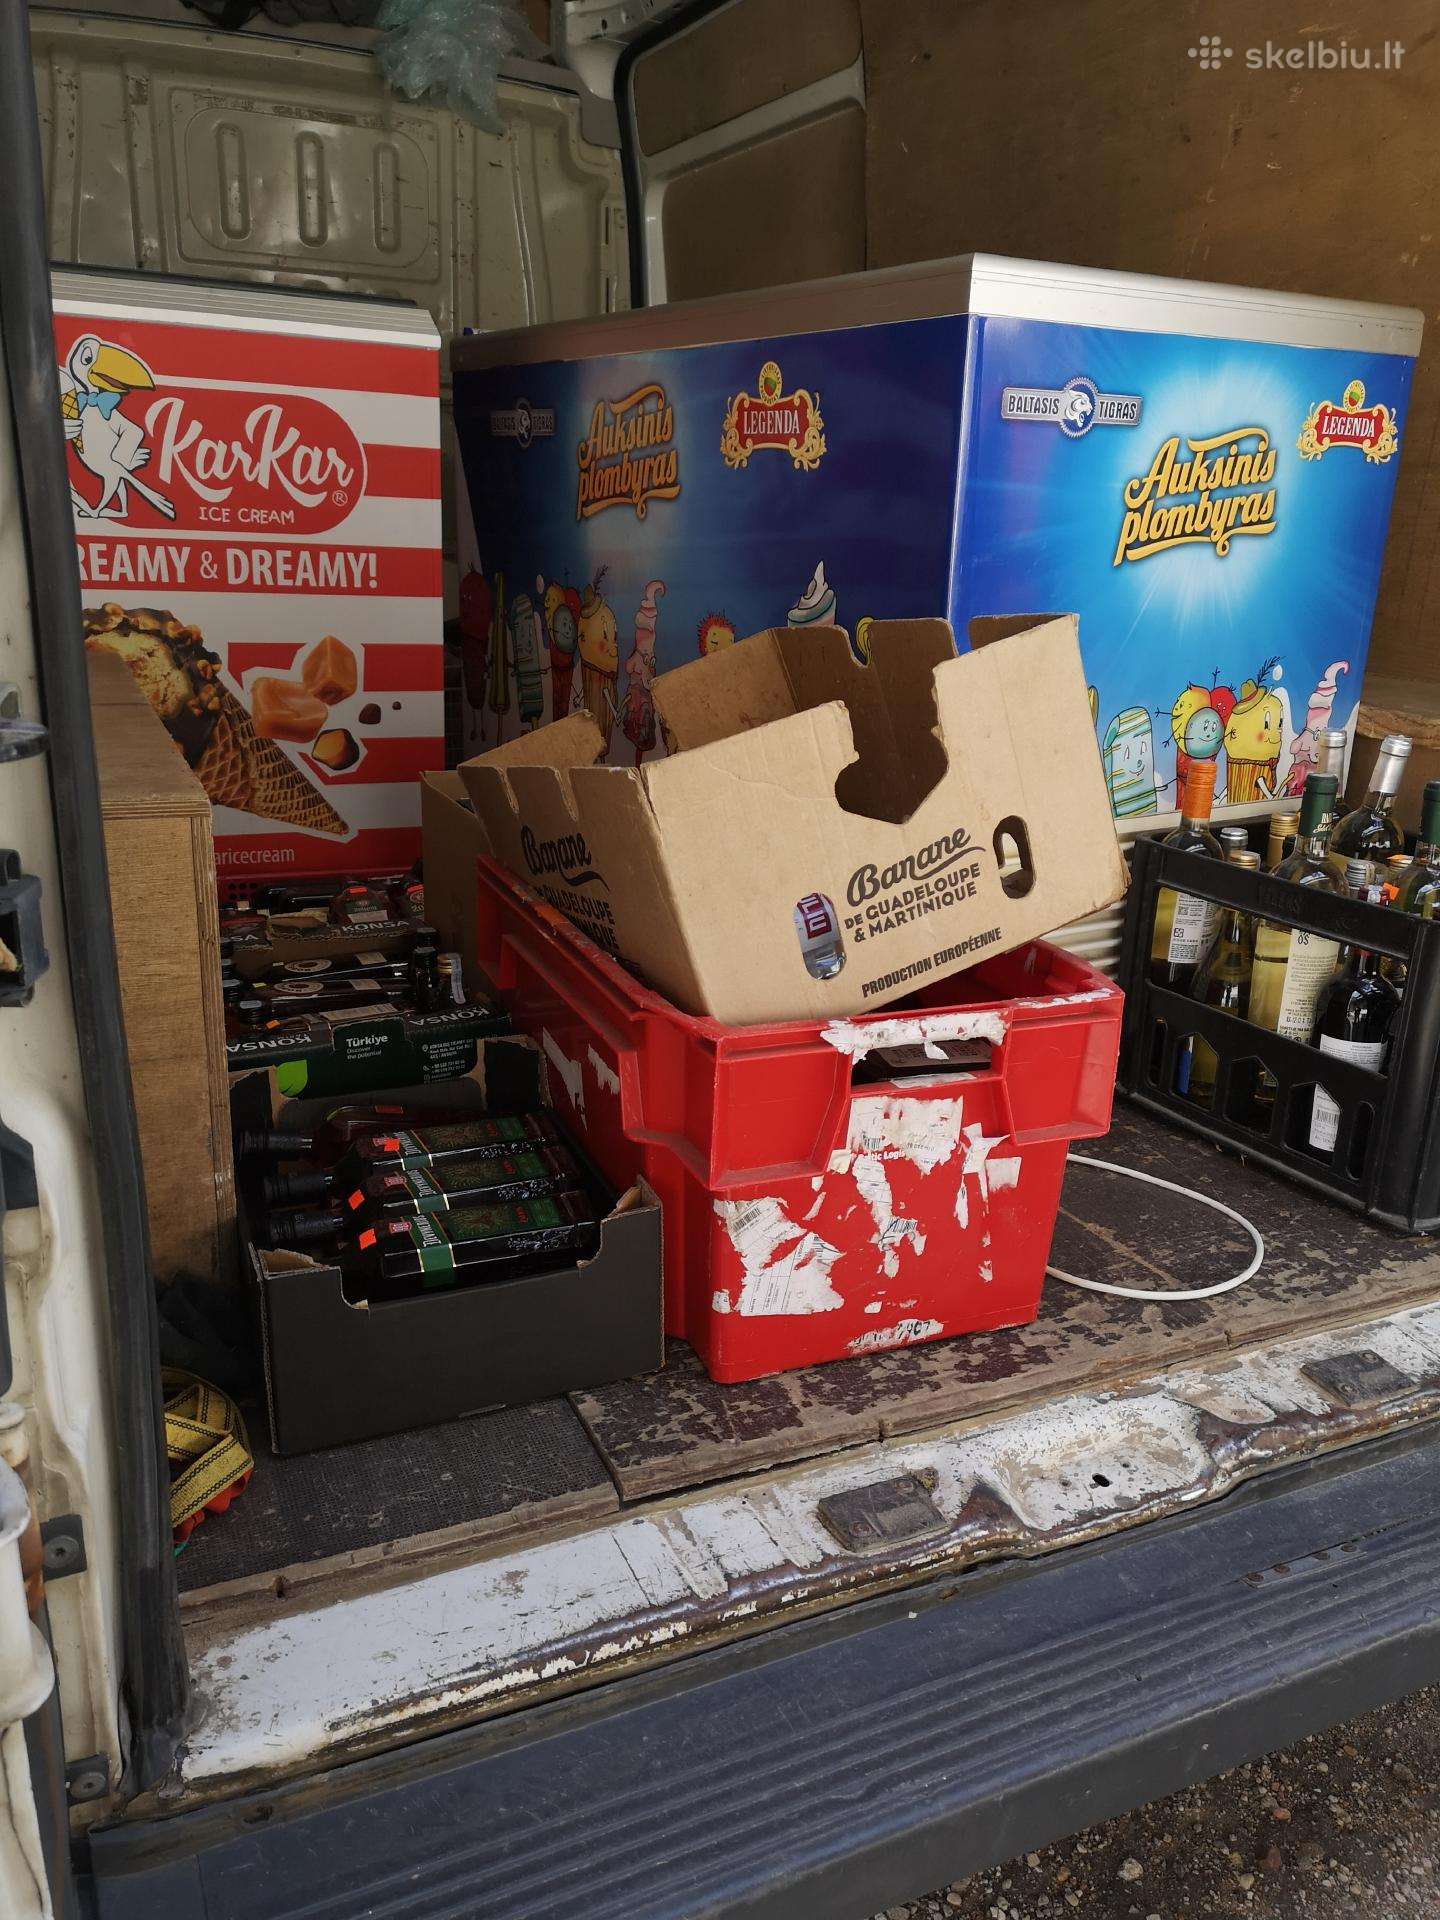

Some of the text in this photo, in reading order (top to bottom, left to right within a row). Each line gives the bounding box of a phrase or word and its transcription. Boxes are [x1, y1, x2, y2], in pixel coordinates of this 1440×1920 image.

[578, 385, 673, 468] Auksinis
[743, 409, 801, 435] LEGENDA
[1008, 393, 1139, 421] BALTASIS TIGRAS
[1321, 415, 1375, 438] LEGENDA
[144, 397, 355, 507] KarKar
[576, 449, 682, 520] plombyras
[1124, 428, 1277, 509] Auksinis
[199, 506, 295, 525] ICE CREAM
[1113, 488, 1277, 568] plombyras
[200, 550, 218, 580] &
[226, 548, 378, 589] DREAMY!
[844, 862, 981, 930] DE GUADELOUPE
[847, 827, 986, 907] Banane
[854, 881, 978, 944] & MARTINIQUE
[861, 926, 1003, 998] PRODUCTION EUROPÉENNE
[346, 1032, 388, 1048] Türkiye
